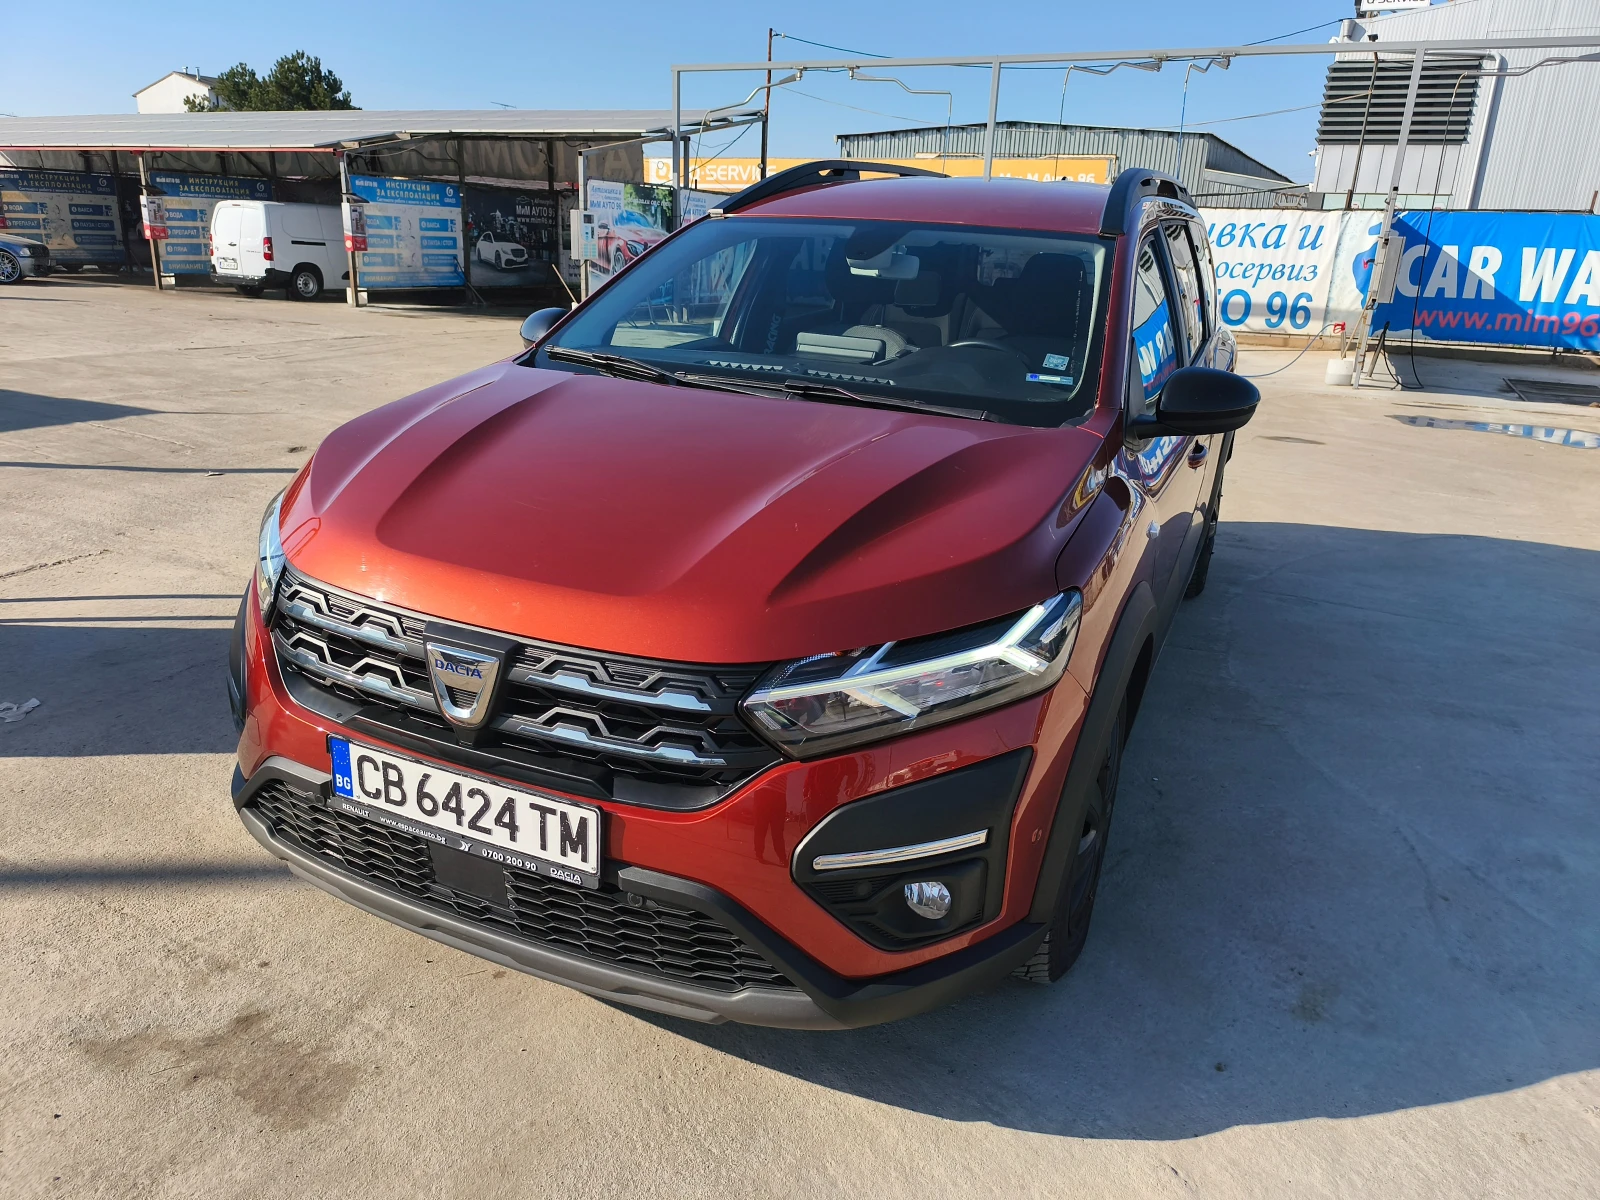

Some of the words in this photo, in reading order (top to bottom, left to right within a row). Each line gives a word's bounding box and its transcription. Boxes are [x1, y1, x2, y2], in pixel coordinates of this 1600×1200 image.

[28, 173, 80, 182] ИНСТРУКЦИЯ
[188, 177, 239, 187] ИНСТРУКЦИЯ
[386, 181, 430, 191] ИНСТРУКЦИЯ
[531, 206, 548, 217] АУТО
[602, 201, 615, 210] АУТО
[1298, 224, 1325, 251] и
[1215, 261, 1319, 289] осервиз
[1397, 244, 1503, 300] CAR
[1264, 291, 1313, 330] 96
[435, 658, 483, 680] DACIA
[335, 773, 351, 790] BG
[416, 772, 520, 843] 6424
[529, 802, 589, 864] TM
[342, 803, 370, 818] RENAULT
[379, 816, 447, 844] www.espaceauto.bg
[482, 848, 504, 861] 0700
[506, 855, 523, 867] 200
[525, 861, 537, 871] 90
[550, 867, 581, 882] DACIA
